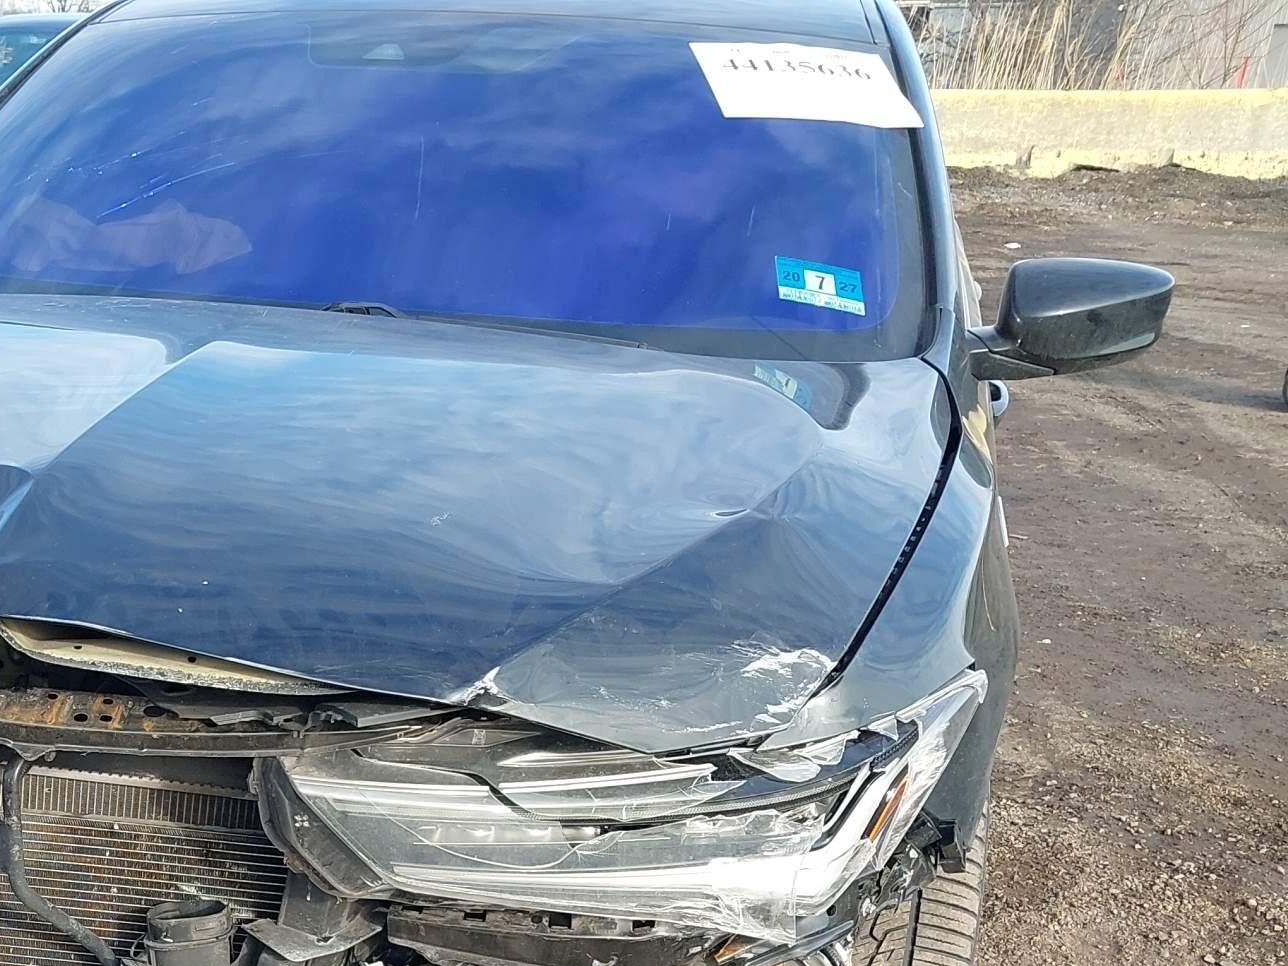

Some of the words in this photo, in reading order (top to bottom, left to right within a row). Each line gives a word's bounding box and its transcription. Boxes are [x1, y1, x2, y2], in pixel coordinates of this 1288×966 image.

[721, 58, 872, 80] 44135636
[782, 270, 800, 282] 20
[815, 275, 826, 290] 7
[838, 281, 857, 293] 27
